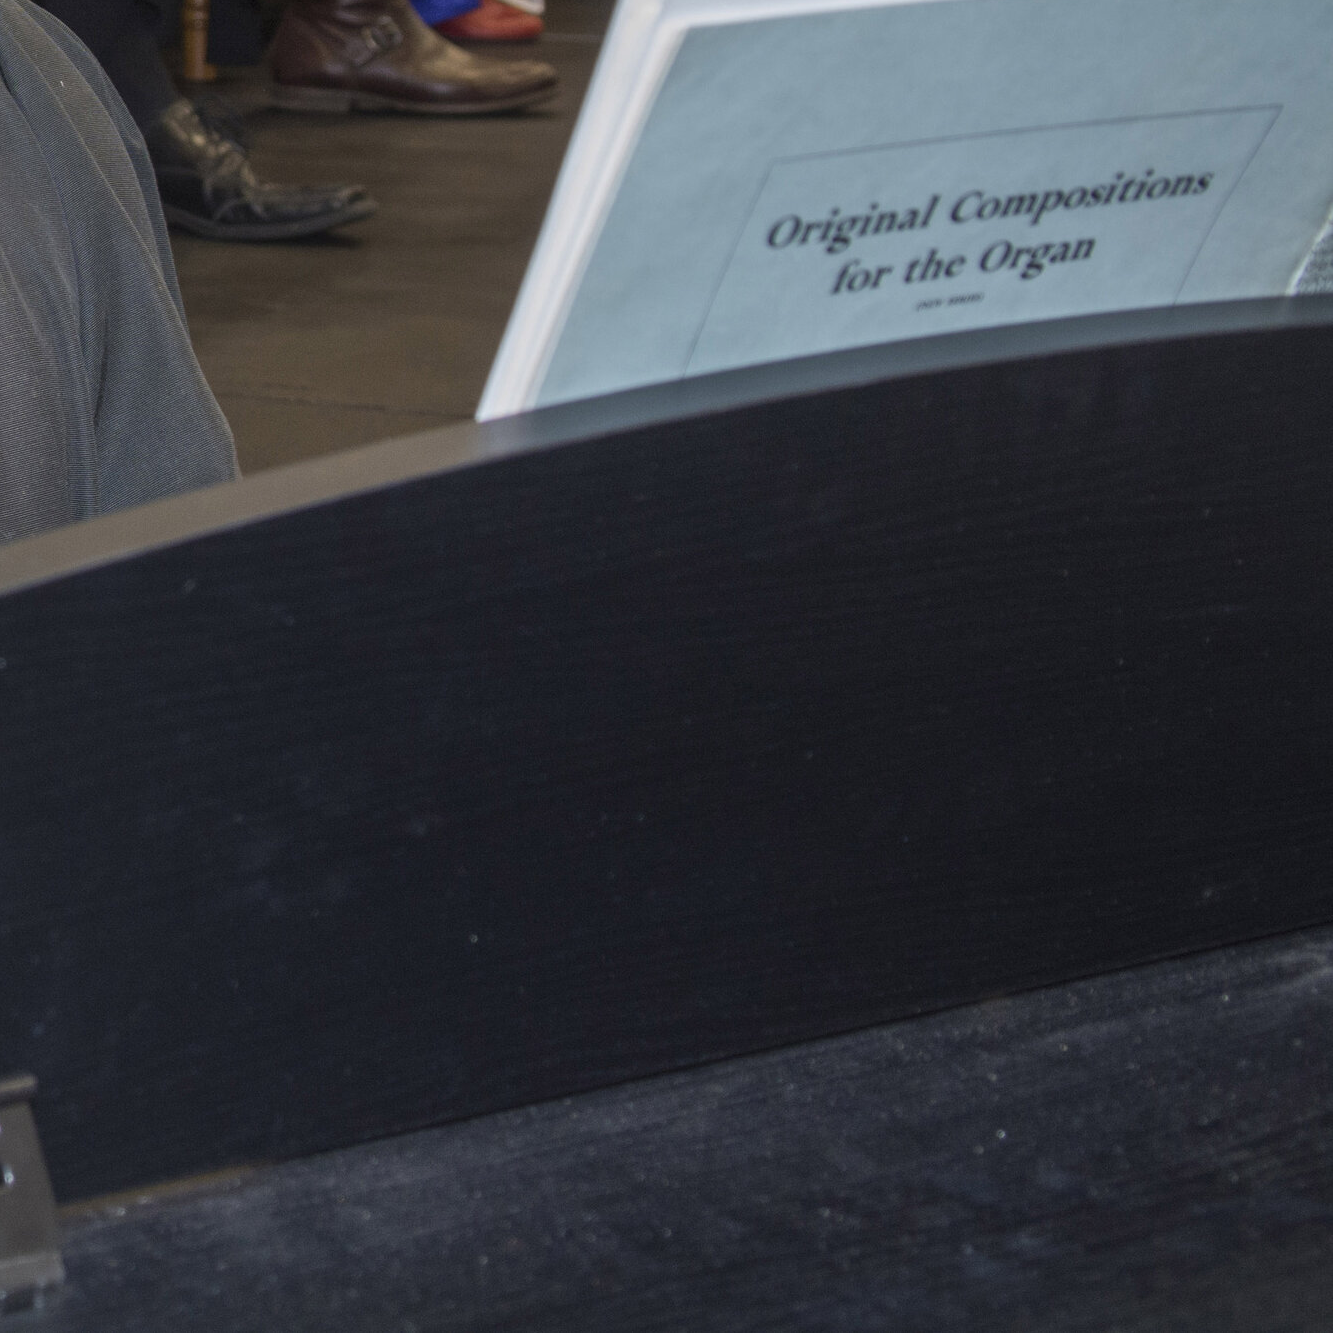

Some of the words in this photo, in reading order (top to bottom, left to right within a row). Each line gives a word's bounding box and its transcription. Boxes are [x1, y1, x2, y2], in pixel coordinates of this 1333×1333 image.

[766, 194, 941, 255] Original
[949, 168, 1215, 226] Compositions
[829, 258, 894, 296] for
[903, 247, 967, 285] the
[978, 237, 1097, 281] Organ
